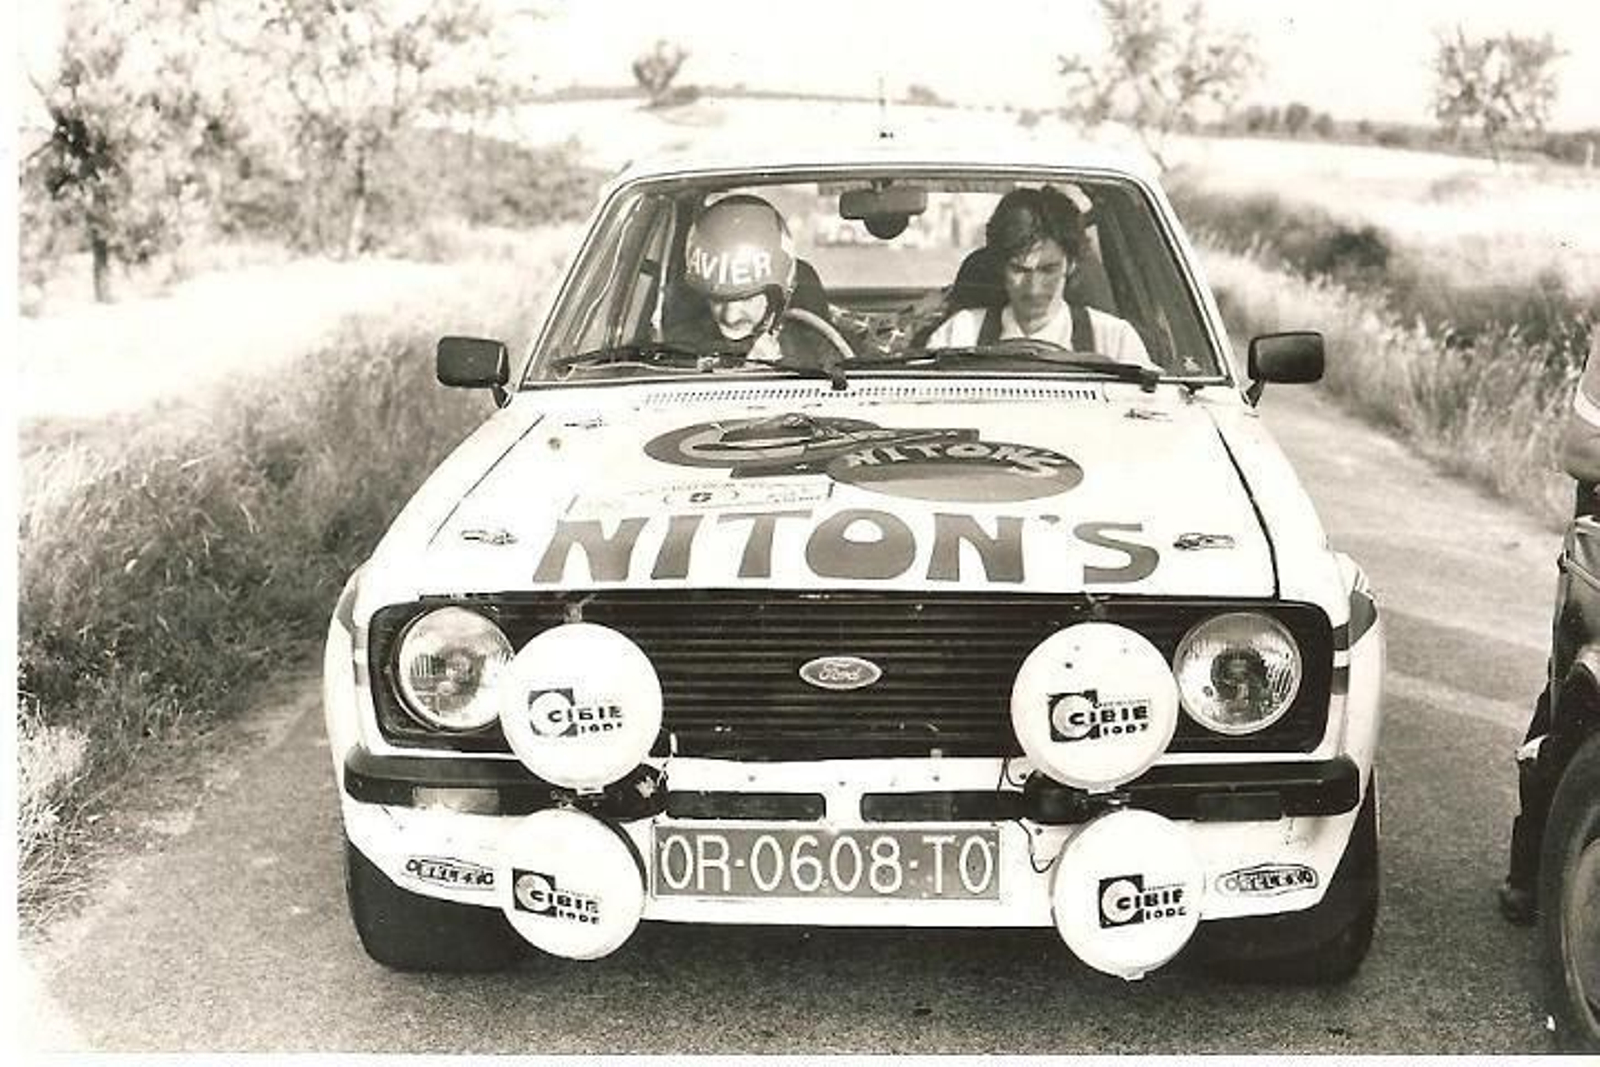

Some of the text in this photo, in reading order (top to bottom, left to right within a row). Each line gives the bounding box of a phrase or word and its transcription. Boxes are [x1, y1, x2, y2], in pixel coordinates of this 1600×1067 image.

[532, 507, 1161, 585] NITON'S
[819, 661, 862, 681] Ford
[1068, 705, 1149, 726] CIBIE
[1116, 888, 1184, 910] CIBIE
